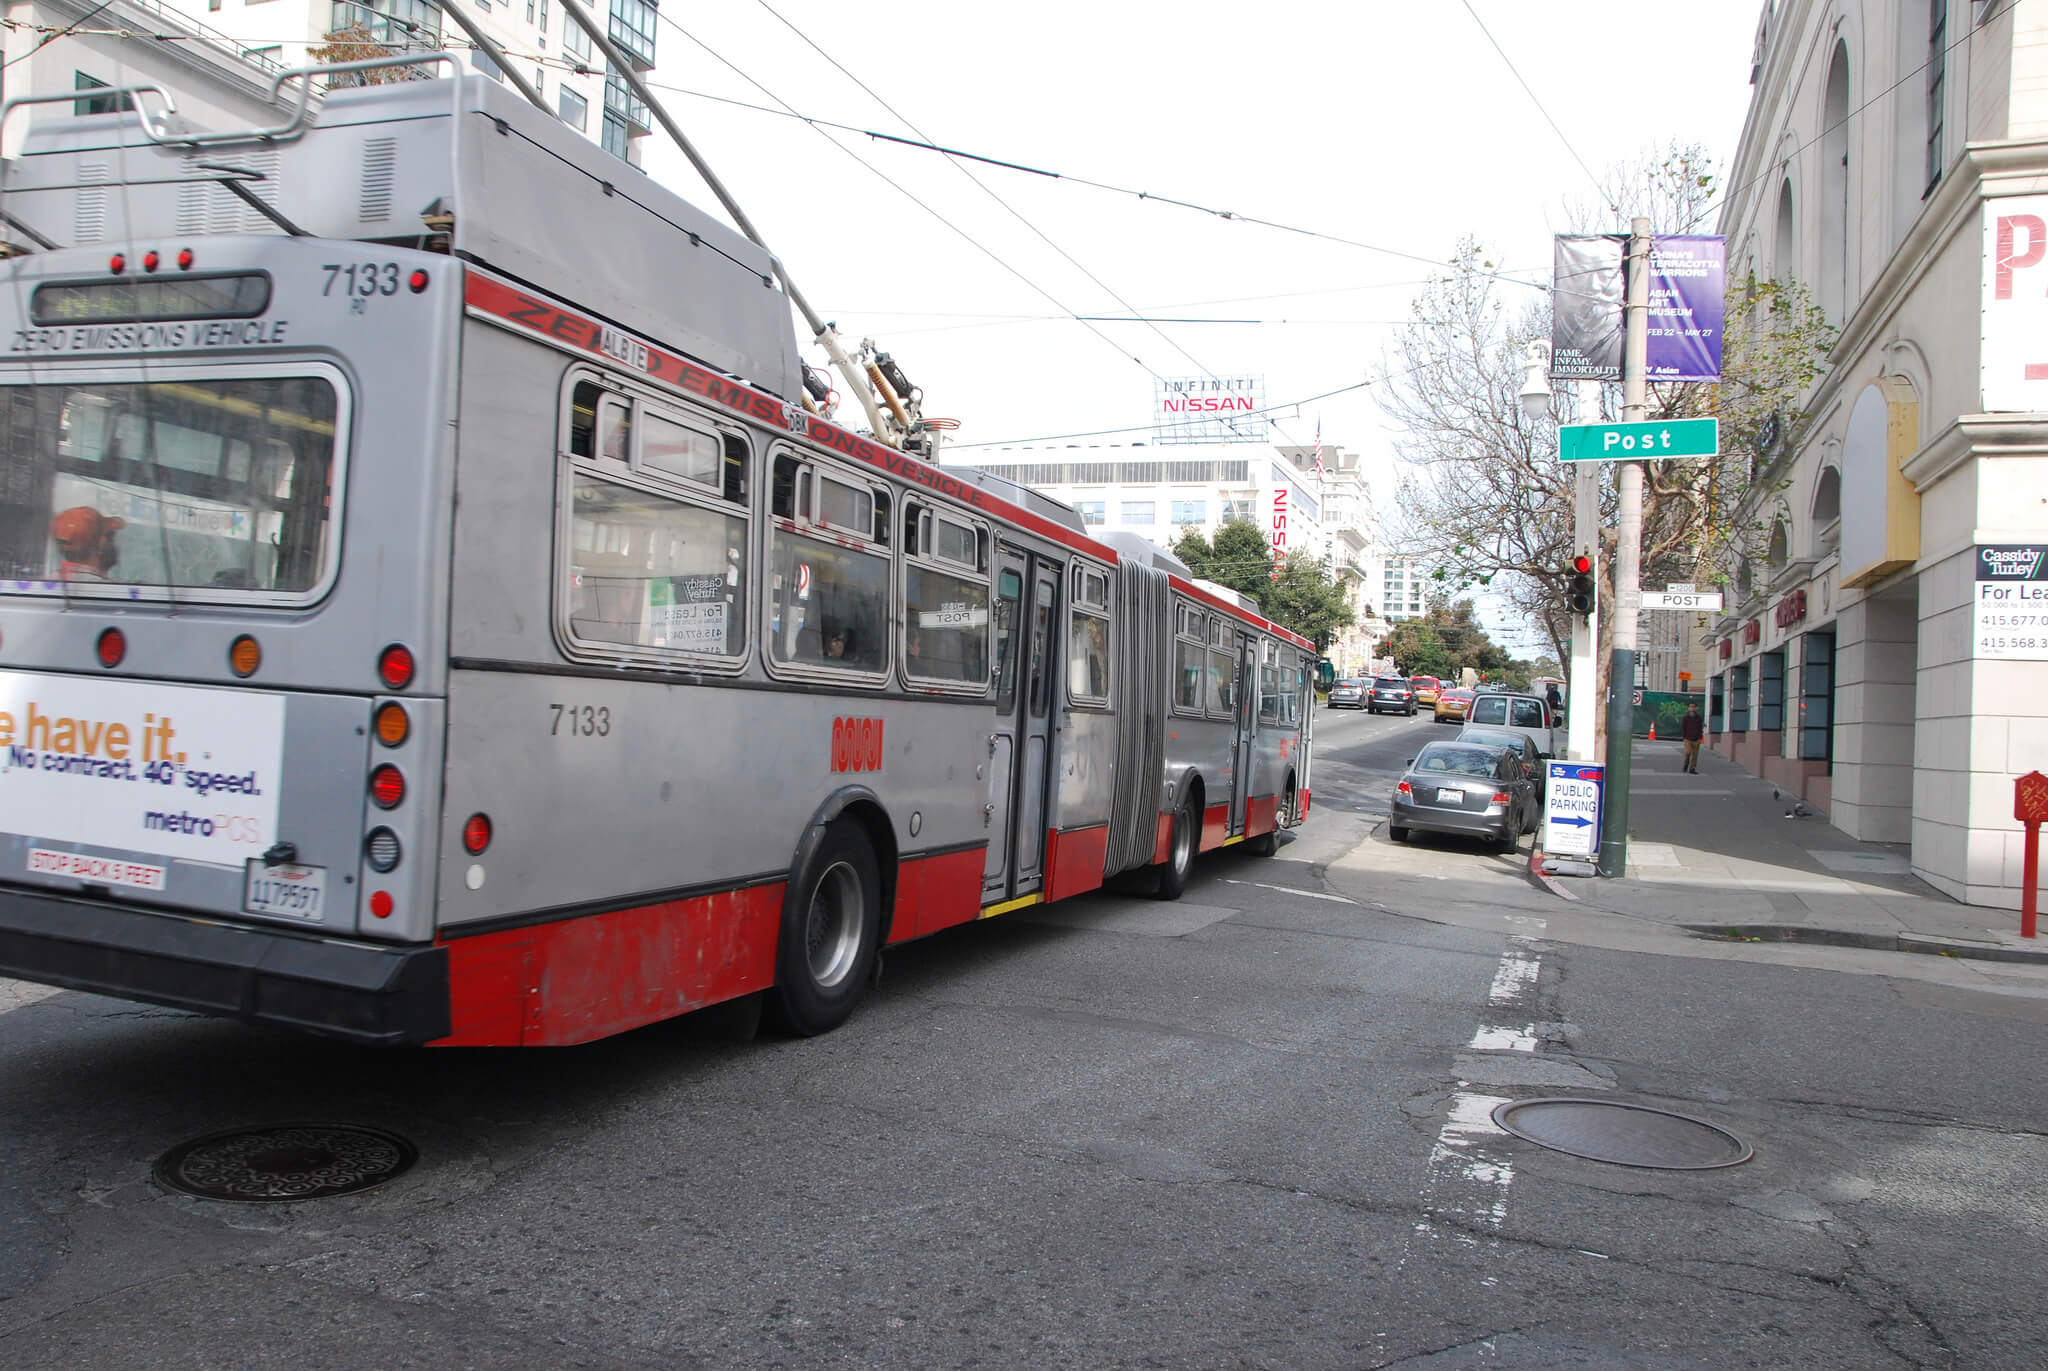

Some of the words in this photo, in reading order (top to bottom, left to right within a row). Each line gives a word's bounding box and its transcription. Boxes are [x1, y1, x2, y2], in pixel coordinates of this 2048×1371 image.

[1649, 260, 1721, 269] TERRACOTTA
[1650, 268, 1708, 277] WARRIORS
[321, 262, 400, 297] 7133
[1648, 289, 1679, 298] ASIAN
[1648, 298, 1669, 307] ART
[1648, 308, 1693, 317] MUSEUM
[11, 328, 66, 352] ZERO
[72, 324, 186, 350] EMISSIONS
[191, 320, 289, 347] VEHICLE
[1647, 329, 1663, 337] FEB
[1664, 329, 1675, 337] 22
[1685, 329, 1701, 337] MAY
[1702, 329, 1713, 337] 27
[1655, 366, 1680, 375] Asian
[1164, 378, 1254, 392] INFINITI
[1163, 396, 1254, 413] NISSAN
[1603, 429, 1671, 451] Post
[885, 452, 985, 507] VEHICLE
[1981, 548, 2042, 564] Cassidy
[1988, 561, 2036, 579] Turley
[1981, 584, 2012, 600] For
[1662, 595, 1702, 607] POST
[549, 703, 610, 737] 7133
[26, 702, 130, 760] have
[142, 712, 188, 764] it.
[8, 744, 37, 769] No
[42, 754, 138, 782] contract.
[184, 770, 263, 797] speed.
[1555, 784, 1593, 798] PUBLIC
[1550, 798, 1597, 813] PARKING
[144, 810, 261, 844] metroPCS
[34, 851, 70, 871] STOP
[72, 857, 110, 877] BACK
[127, 865, 162, 886] FEET
